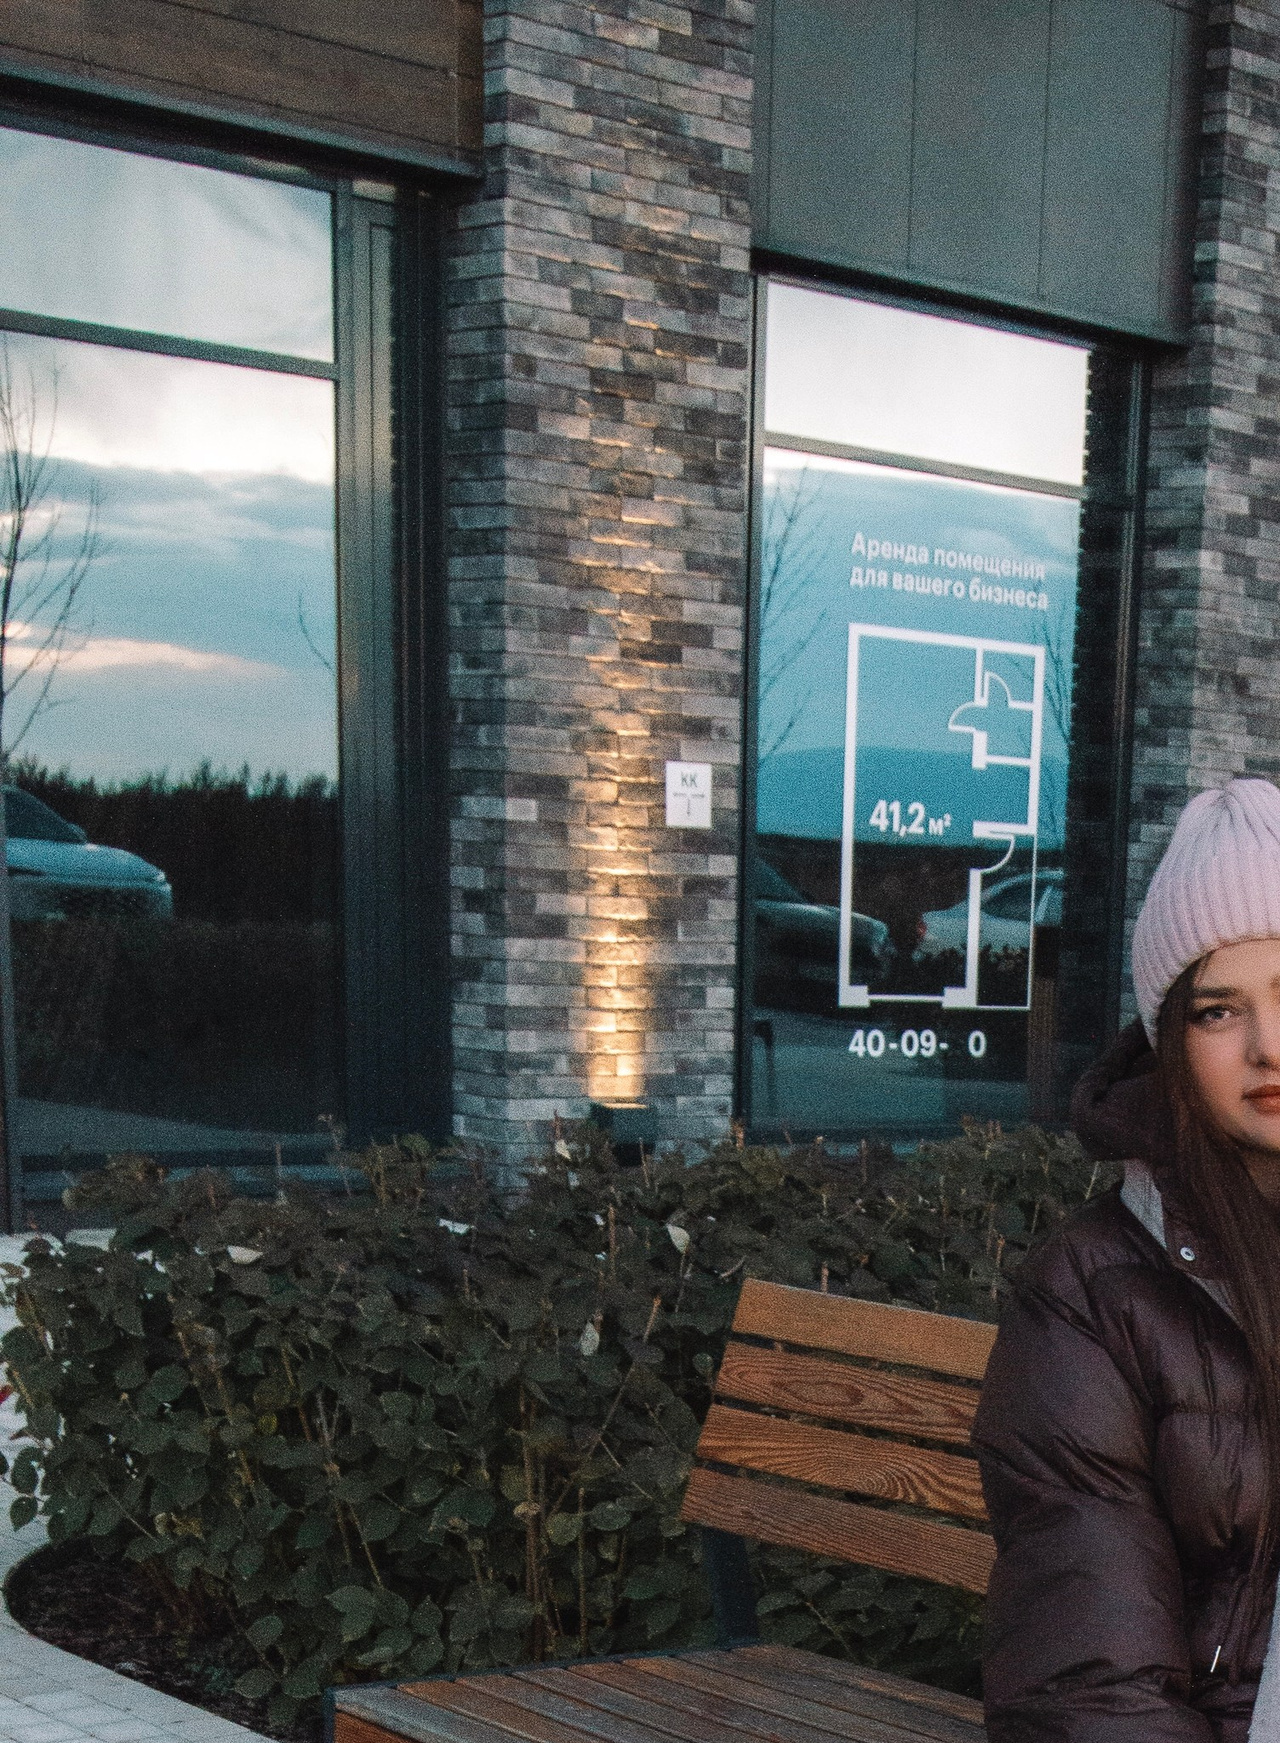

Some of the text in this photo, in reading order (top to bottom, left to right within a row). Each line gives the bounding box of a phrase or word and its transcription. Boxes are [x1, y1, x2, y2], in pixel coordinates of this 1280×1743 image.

[851, 532, 1046, 580] Аренда помещения
[850, 566, 1049, 610] для вашего бизнеса
[869, 799, 925, 837] 41,2
